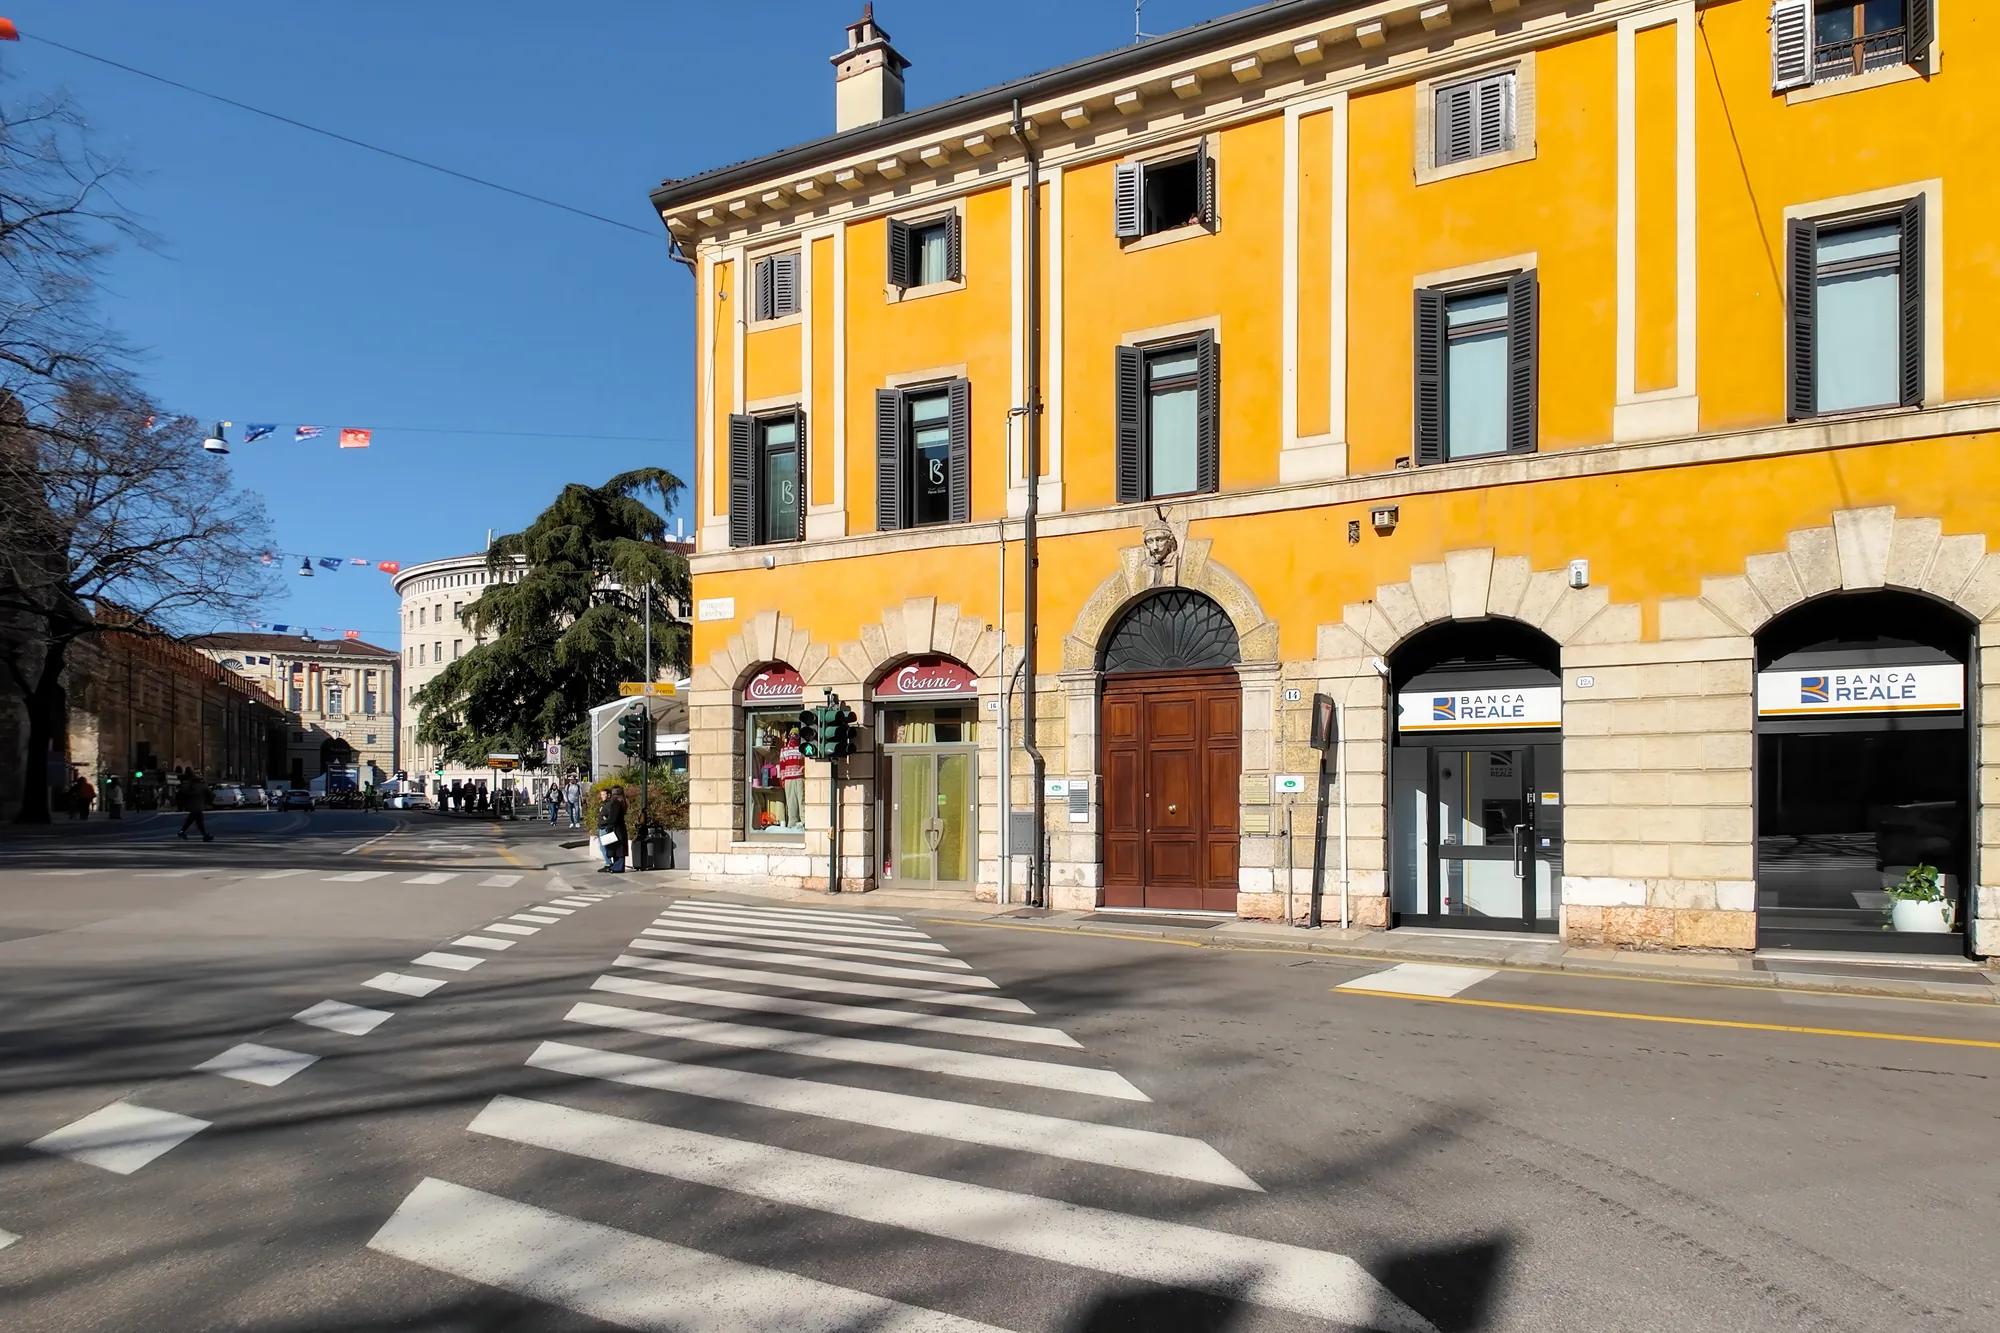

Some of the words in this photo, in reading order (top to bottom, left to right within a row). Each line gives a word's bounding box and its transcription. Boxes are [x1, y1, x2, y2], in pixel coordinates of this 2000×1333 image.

[750, 673, 803, 699] Corsini
[897, 666, 962, 693] Corsini
[1836, 673, 1916, 685] BANCA
[1288, 691, 1298, 700] 14
[1461, 694, 1525, 705] BANCA
[1836, 685, 1917, 701] REALE
[1461, 705, 1525, 719] REALE
